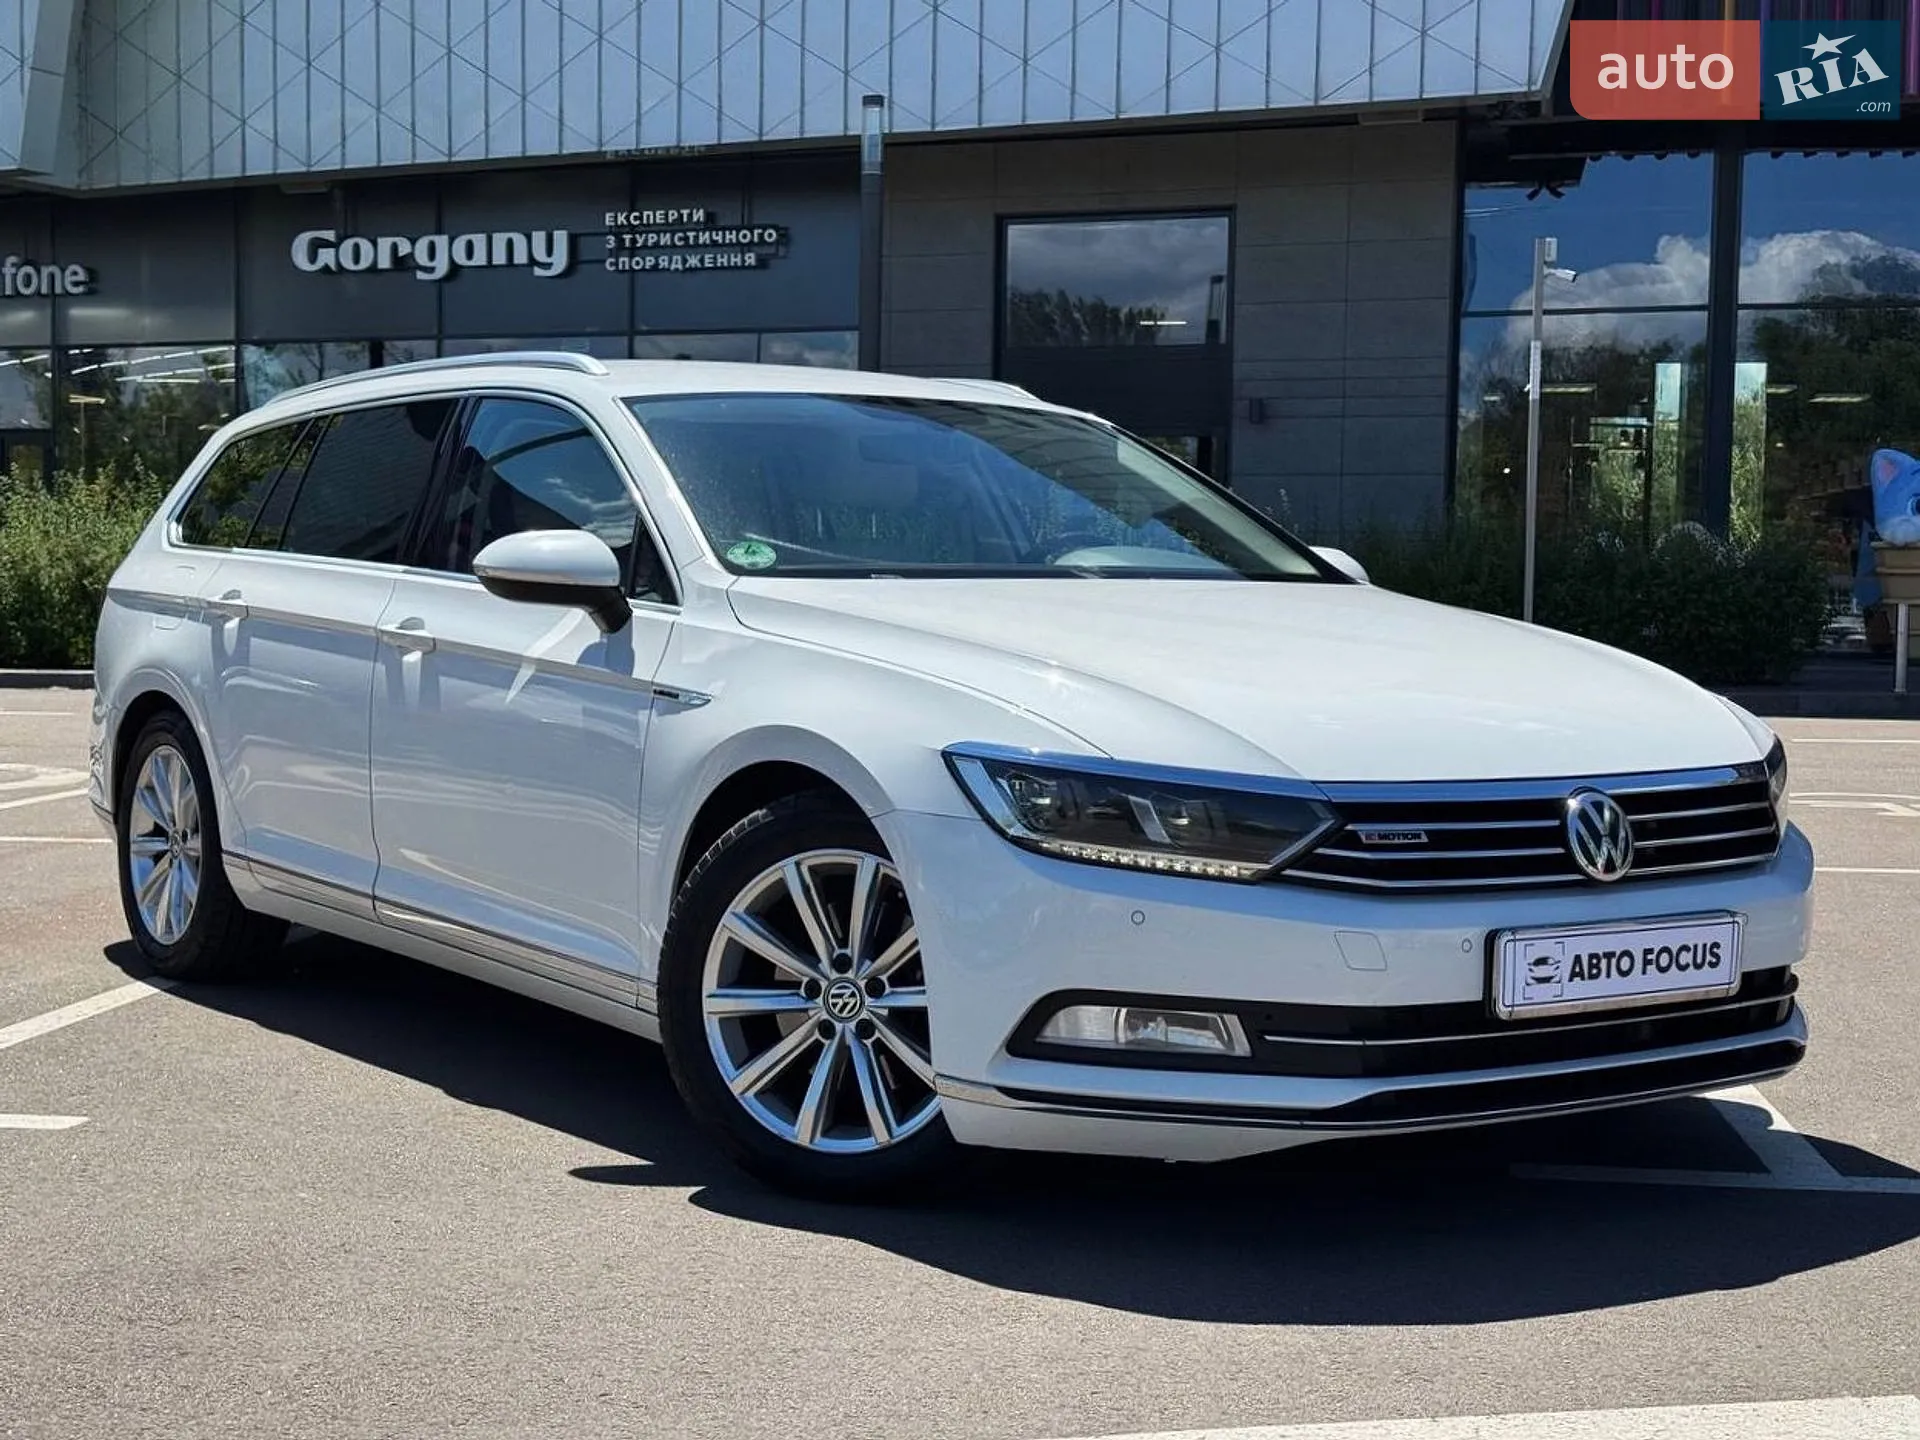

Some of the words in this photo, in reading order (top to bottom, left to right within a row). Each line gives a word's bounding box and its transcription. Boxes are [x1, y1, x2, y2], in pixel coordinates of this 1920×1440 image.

[605, 208, 705, 226] ЕКСПЕРТИ
[622, 229, 777, 248] ТУРИСТИЧНОГО
[291, 229, 569, 280] Gorgany
[605, 253, 756, 271] СПОРЯДЖЕННЯ
[1642, 941, 1722, 976] FOCUS
